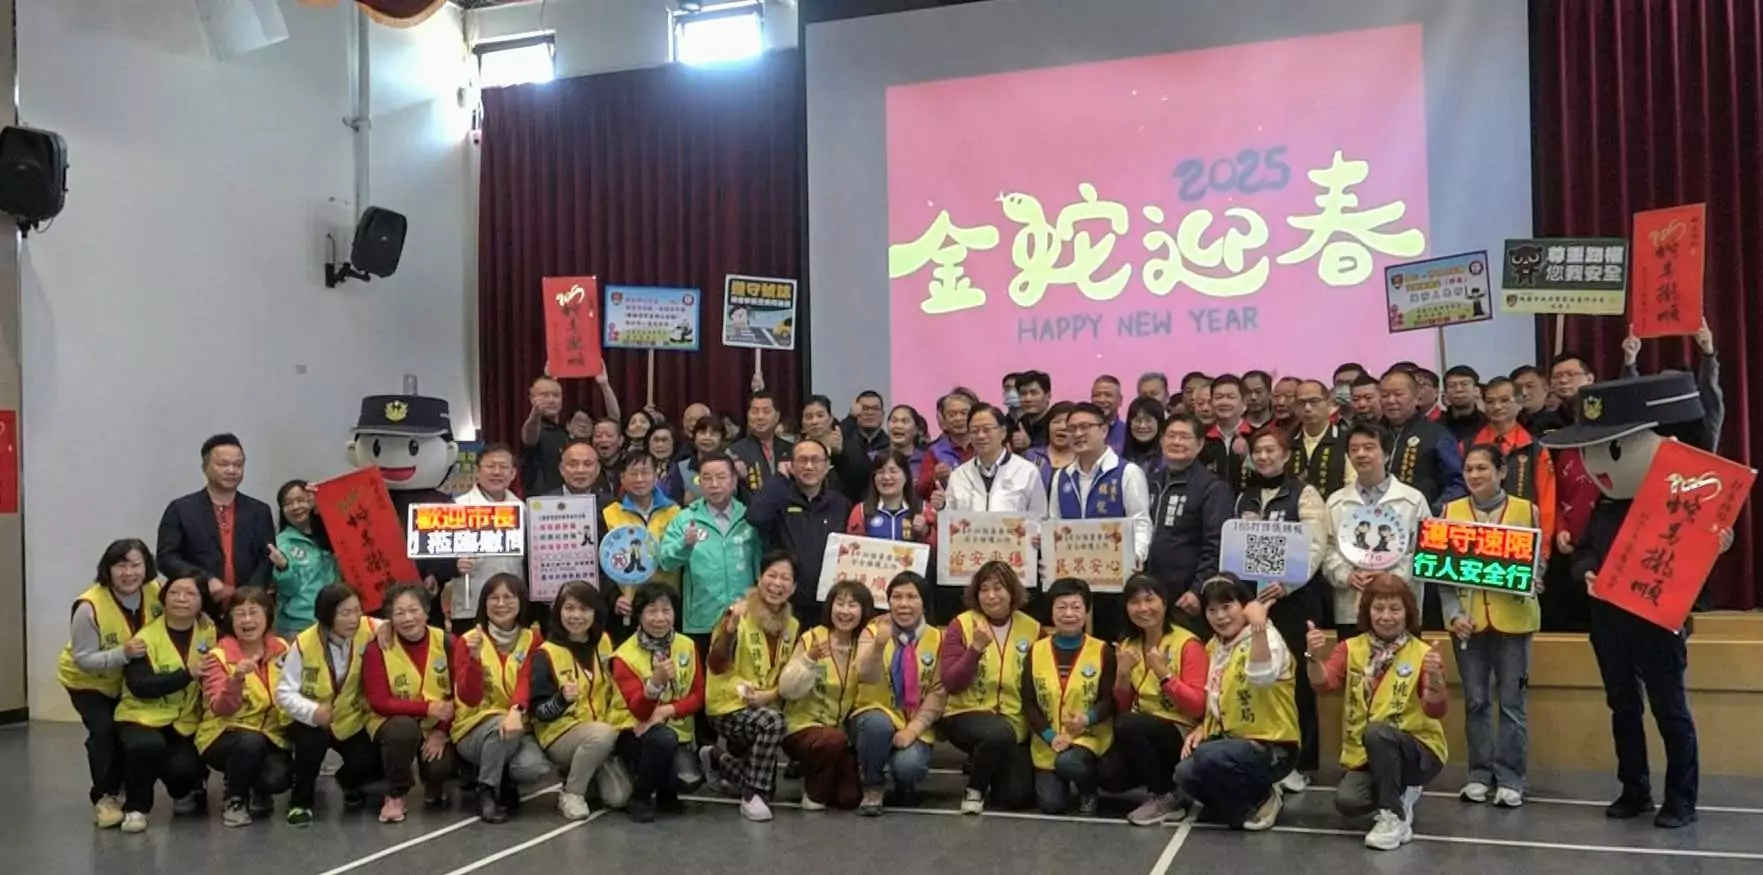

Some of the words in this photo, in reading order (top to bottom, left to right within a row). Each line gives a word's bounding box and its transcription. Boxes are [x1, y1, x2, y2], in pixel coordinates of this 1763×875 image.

[1173, 146, 1292, 202] 2025
[889, 150, 1426, 314] 金蛇迎春
[1545, 264, 1622, 282] 您我安全
[1017, 315, 1103, 344] HAPPY
[1117, 311, 1172, 337] NEW
[1187, 306, 1258, 333] YEAR
[416, 506, 517, 530] 歡迎市長
[1420, 519, 1534, 562] 遵守速限
[1414, 552, 1532, 590] 行人安全行
